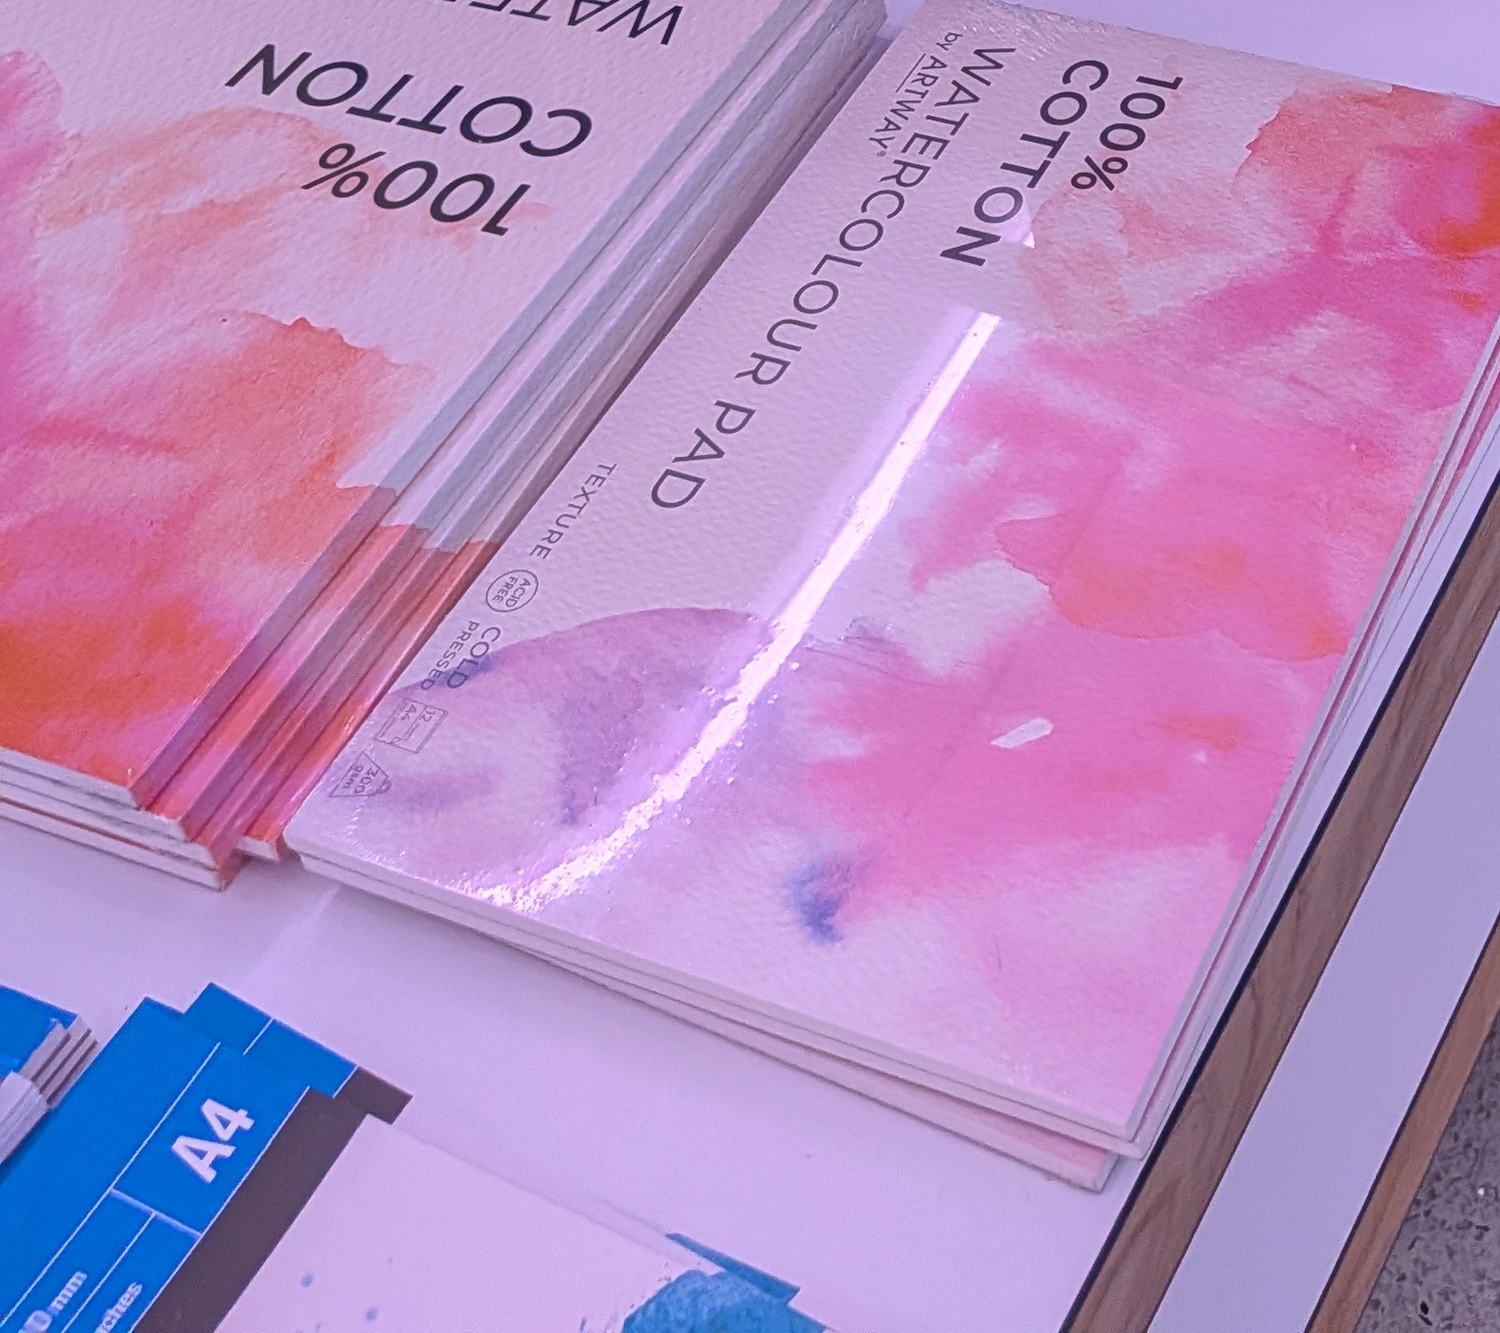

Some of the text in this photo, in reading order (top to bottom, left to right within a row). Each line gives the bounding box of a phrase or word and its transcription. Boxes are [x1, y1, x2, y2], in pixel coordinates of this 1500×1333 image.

[936, 31, 963, 52] by
[224, 43, 594, 159] COTTON
[1069, 73, 1184, 191] 100%
[302, 141, 532, 237] 100%
[939, 58, 1110, 267] COTTON
[650, 46, 1017, 509] WATERCOLOUR PAD
[529, 462, 618, 560] TEXTURE
[492, 576, 519, 603] FREE
[505, 577, 532, 608] ACID
[420, 619, 480, 692] PRESSED
[446, 626, 502, 689] COLD
[353, 766, 379, 794] 300
[171, 1098, 255, 1186] A4
